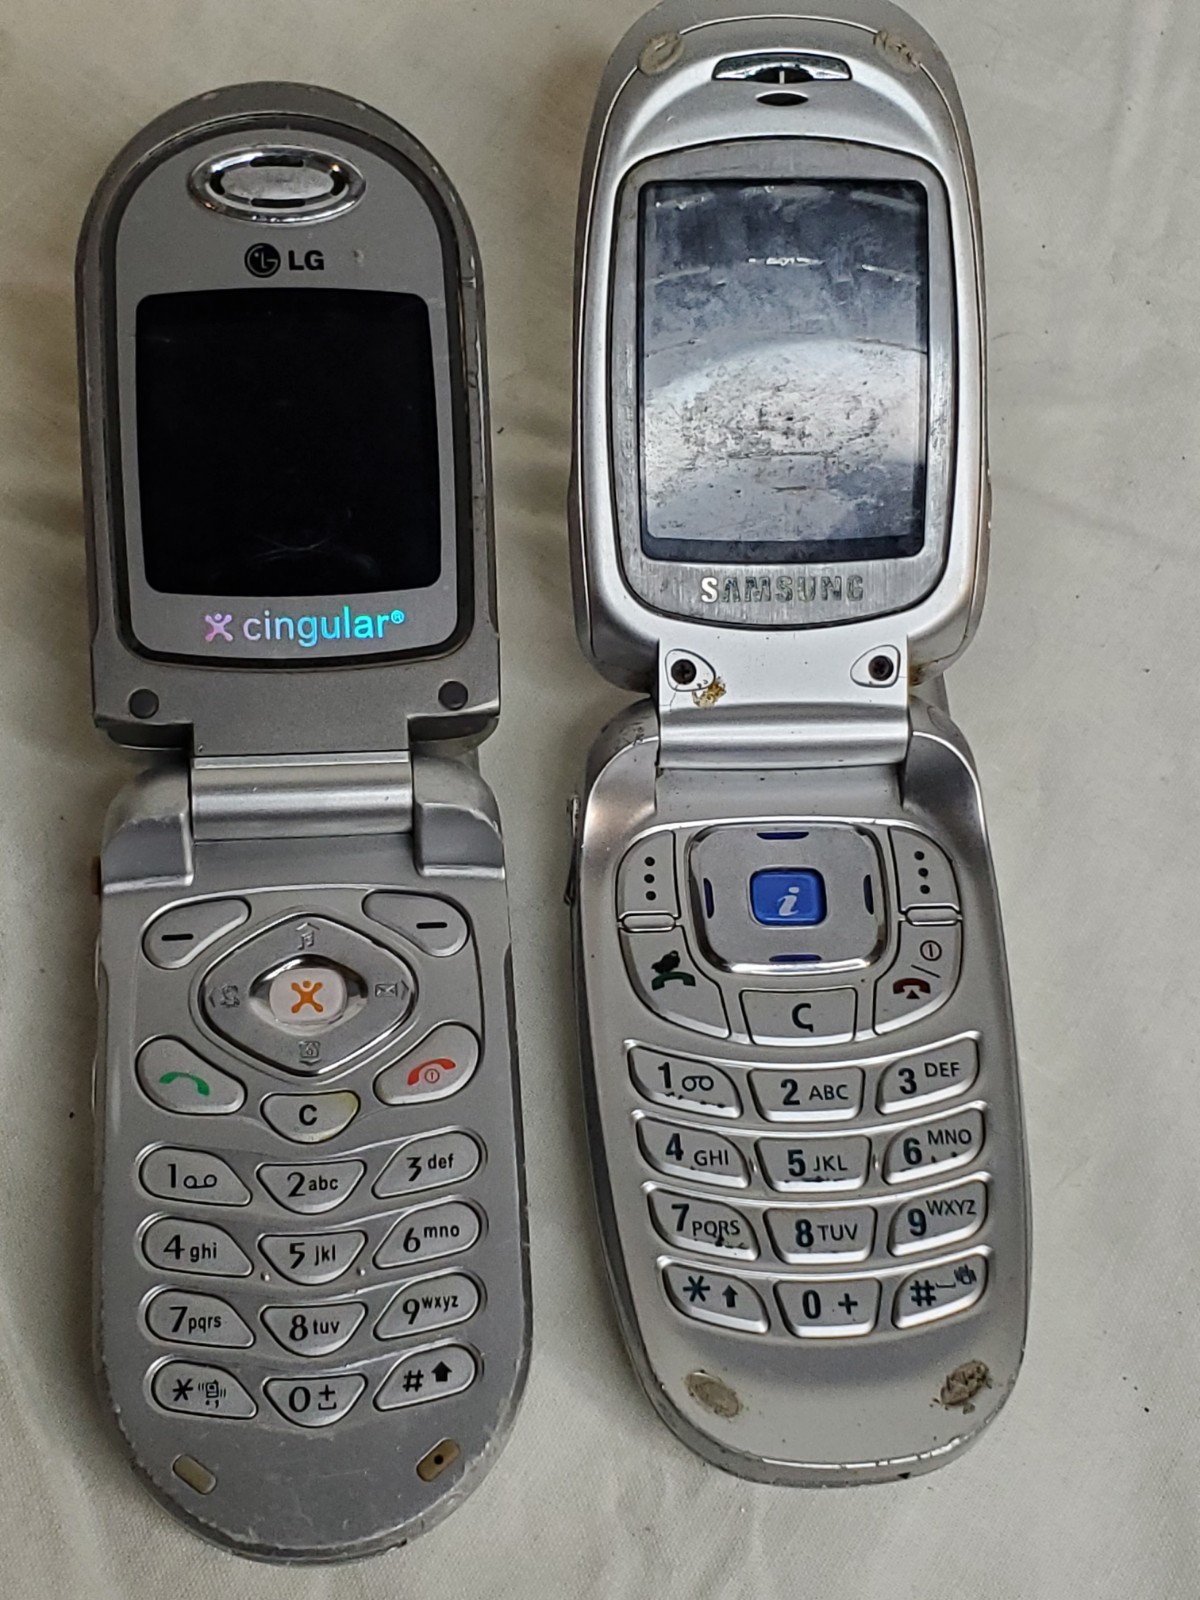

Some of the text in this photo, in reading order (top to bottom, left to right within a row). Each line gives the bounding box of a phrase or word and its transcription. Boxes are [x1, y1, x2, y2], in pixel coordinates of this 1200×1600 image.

[288, 250, 325, 271] LG
[701, 575, 864, 603] SAMSUNG
[657, 1062, 673, 1089] 1
[898, 1061, 960, 1095] 3 DEF
[780, 1078, 849, 1106] 2 ABC
[298, 1104, 319, 1126] C
[665, 1132, 729, 1167] 4 GHI
[903, 1128, 972, 1166] 6 MNO
[168, 1163, 177, 1189] 1
[406, 1153, 455, 1182] 3 def
[787, 1149, 848, 1177] 5 JKL
[286, 1171, 339, 1198] 2 abc
[671, 1203, 741, 1240] 7 PQRS
[907, 1199, 977, 1237] 9 WXYZ
[403, 1225, 460, 1253] 6 mno
[795, 1218, 858, 1248] 8 TUV
[163, 1234, 217, 1263] 4 ghi
[289, 1242, 337, 1269] 5 jkl
[802, 1289, 822, 1319] 0
[910, 1279, 937, 1307] #
[169, 1306, 222, 1333] 7 pqrs
[402, 1293, 459, 1325] 9 wxyz
[289, 1314, 340, 1341] 8 tuv
[402, 1369, 424, 1393] #
[289, 1385, 311, 1413] 0
